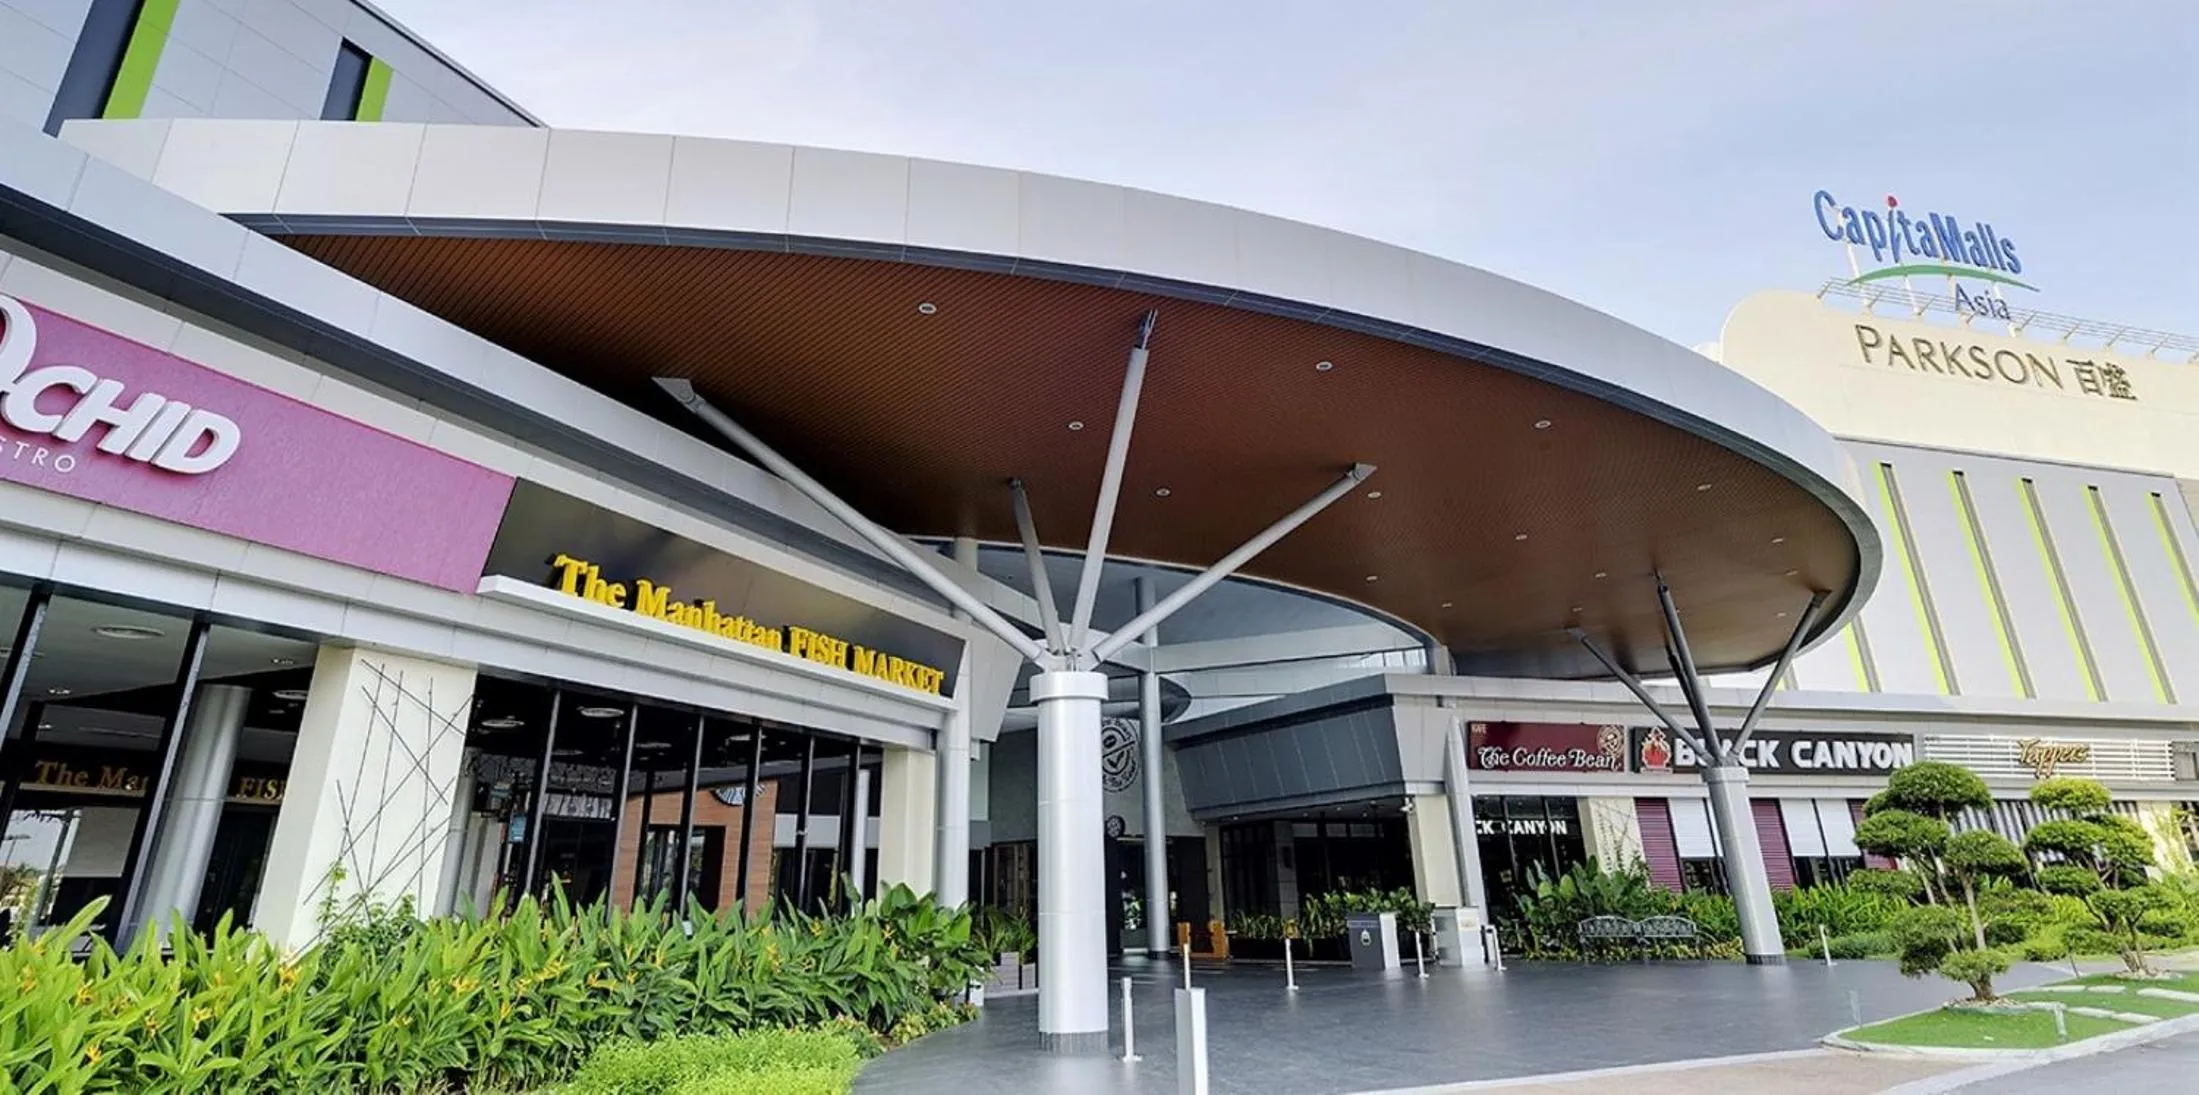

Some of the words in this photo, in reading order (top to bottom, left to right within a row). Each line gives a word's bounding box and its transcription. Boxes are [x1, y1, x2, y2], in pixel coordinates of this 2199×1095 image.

[1813, 189, 2022, 275] CapitaMalls
[1954, 282, 2011, 320] Asia
[1854, 323, 2064, 390] PARKSON
[2065, 360, 2138, 400] 百盛
[0, 436, 76, 473] TRO
[554, 553, 627, 609] The
[635, 578, 783, 653] Manhattan
[788, 626, 849, 669] FISH
[852, 645, 944, 696] MARKET
[1477, 745, 1510, 769] The
[1511, 746, 1566, 768] Coffee
[1567, 748, 1617, 771] Bean
[1791, 740, 1914, 769] CANYON
[36, 760, 90, 787] The
[235, 776, 287, 800] FIS
